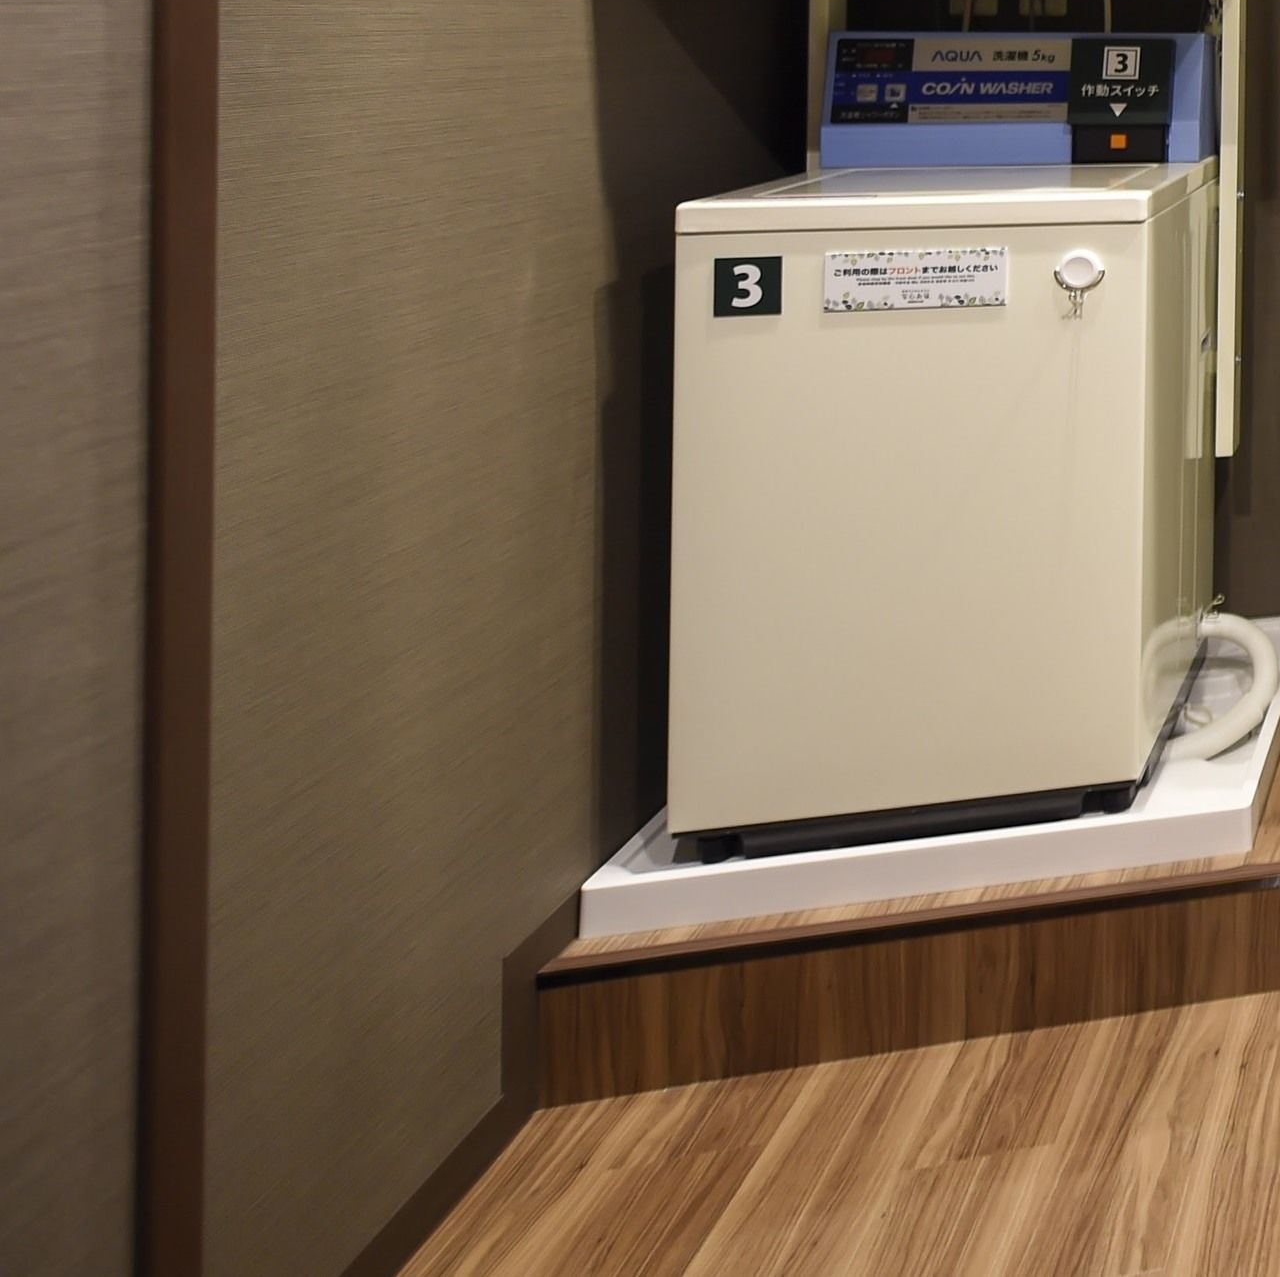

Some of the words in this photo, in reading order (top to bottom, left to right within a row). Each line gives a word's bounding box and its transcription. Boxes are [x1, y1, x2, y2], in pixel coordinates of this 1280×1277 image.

[930, 50, 983, 63] AQUA
[1113, 52, 1129, 73] 3
[978, 81, 1054, 96] WASHER
[1080, 83, 1160, 98] 作動スイッチ
[730, 263, 763, 308] 3
